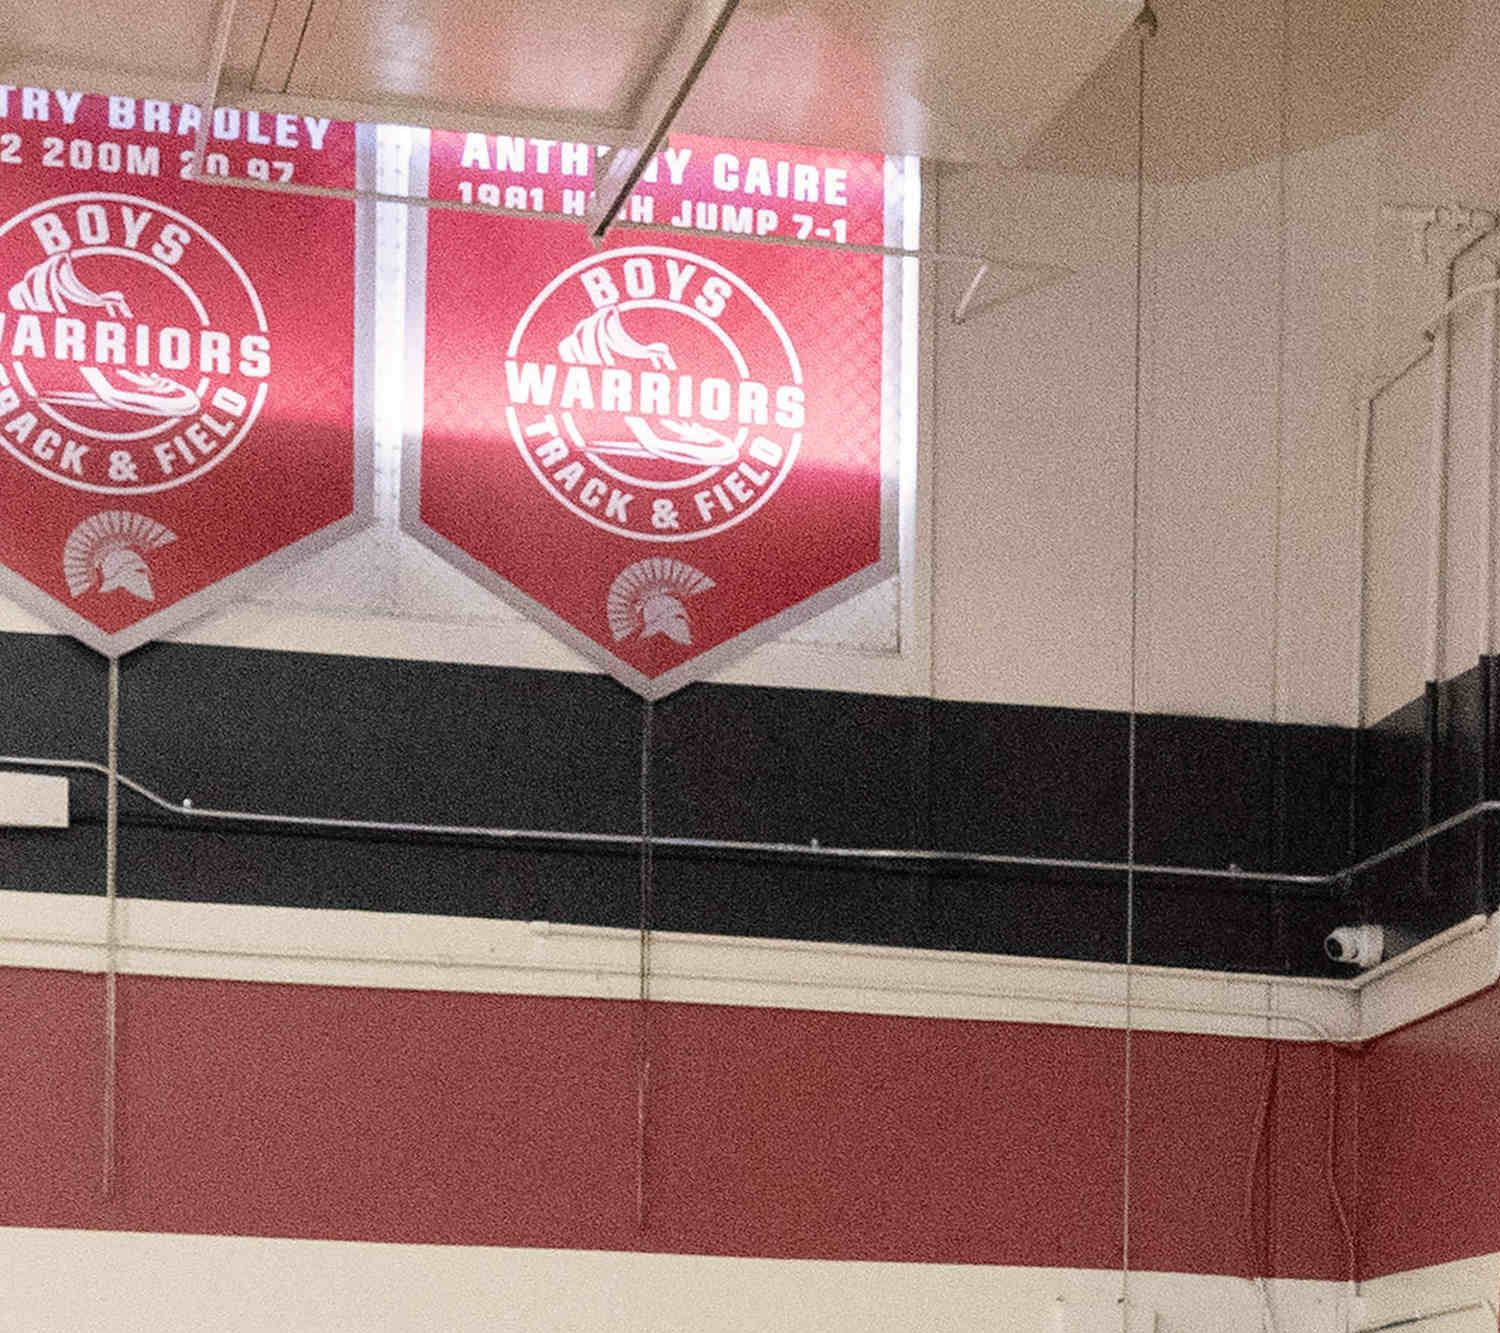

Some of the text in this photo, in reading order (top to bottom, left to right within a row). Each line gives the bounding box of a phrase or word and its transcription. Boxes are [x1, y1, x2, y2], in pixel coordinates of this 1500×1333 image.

[107, 96, 331, 150] BRADLEY
[41, 137, 160, 177] 200M
[461, 131, 849, 206] ANTHY CAIRE
[30, 204, 191, 265] BOYS
[562, 189, 654, 224] HH
[671, 200, 778, 237] JUMP
[792, 214, 848, 244] 7-1
[580, 257, 732, 319] BOYS
[0, 312, 270, 378] ARRIORS
[0, 362, 248, 482] RACK & FIELD
[504, 359, 806, 429] WARRIORS
[525, 413, 783, 530] TRACK & FIELD
